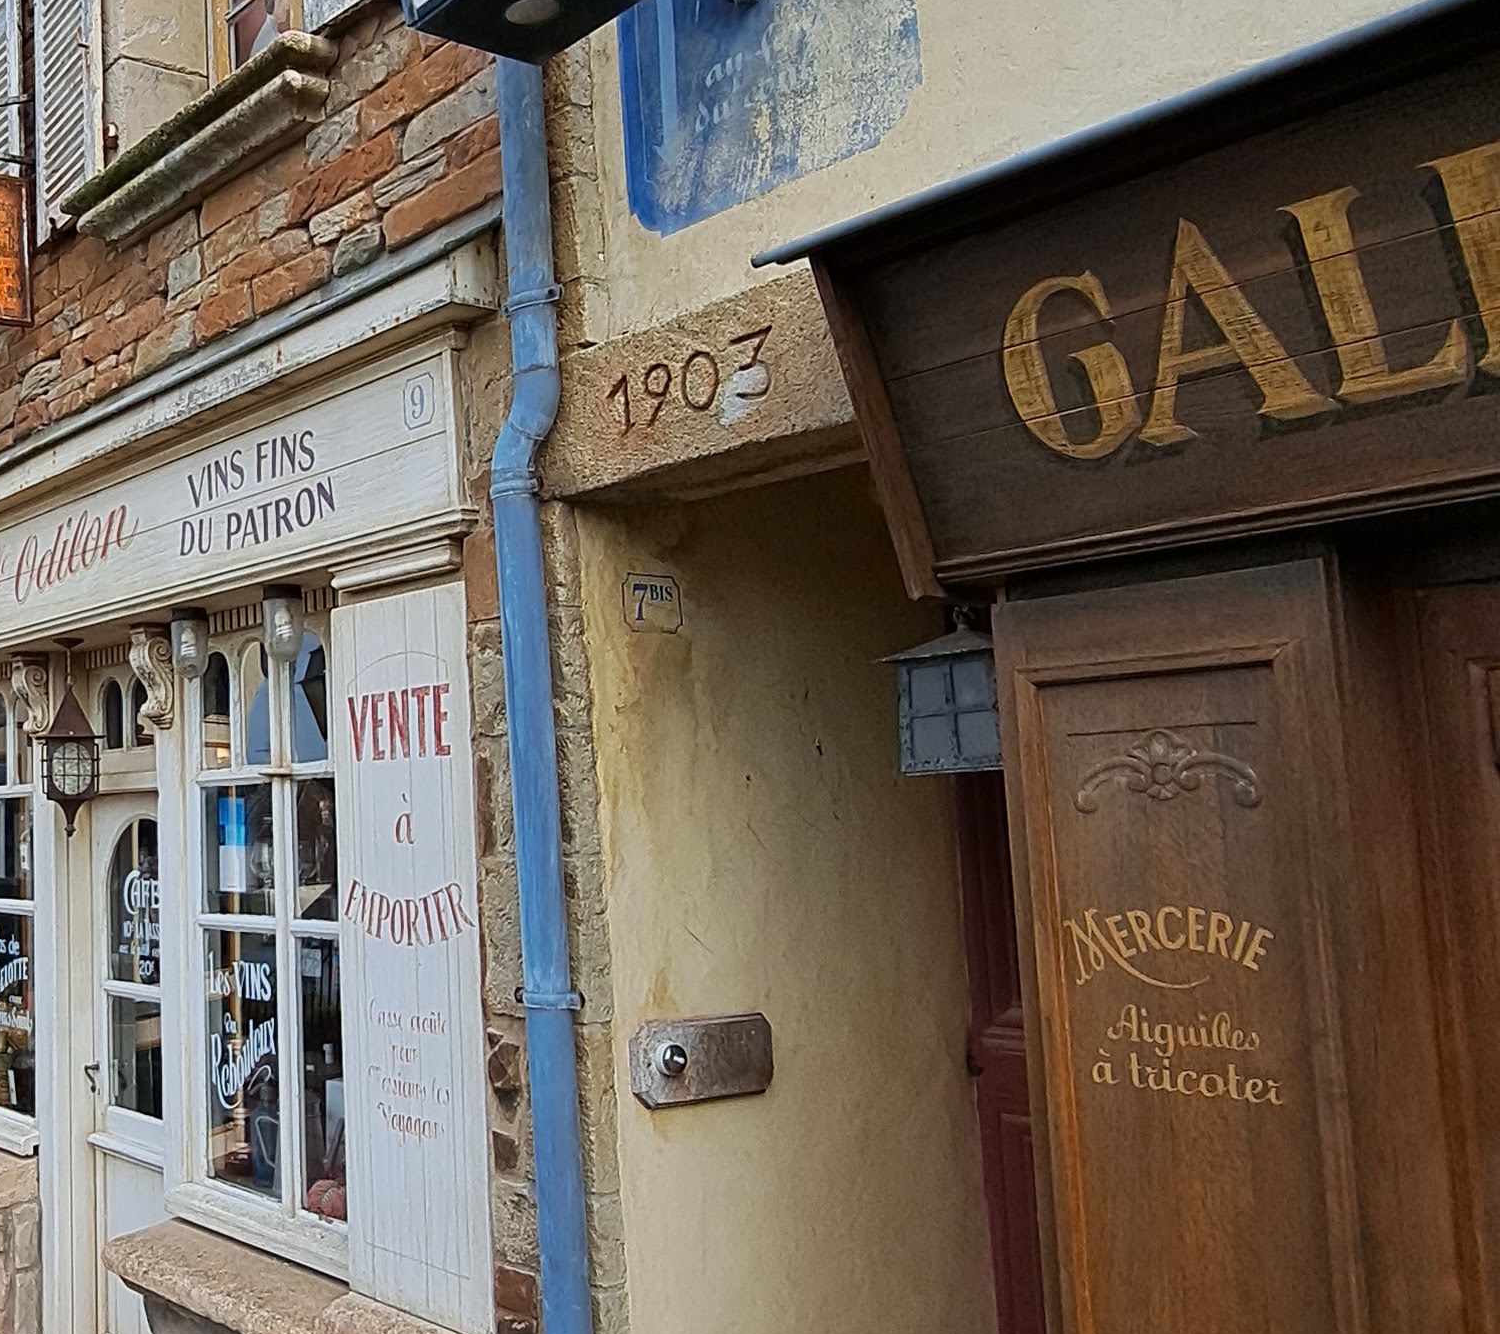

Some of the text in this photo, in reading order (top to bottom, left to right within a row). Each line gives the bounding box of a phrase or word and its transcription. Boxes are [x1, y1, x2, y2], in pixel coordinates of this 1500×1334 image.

[410, 384, 425, 419] 9
[606, 325, 772, 437] 1903
[187, 430, 316, 508] VINS FINS
[180, 476, 335, 556] DU PATRON
[15, 504, 139, 605] Odilon
[347, 683, 451, 762] VENTE
[395, 793, 415, 844] à
[8, 935, 21, 956] de
[344, 879, 476, 947] EMPORTER
[1063, 905, 1275, 989] MERCERIE
[208, 951, 272, 1001] Les VINS
[1107, 1003, 1260, 1057] Aiguilles
[1092, 1048, 1284, 1105] à tricoter
